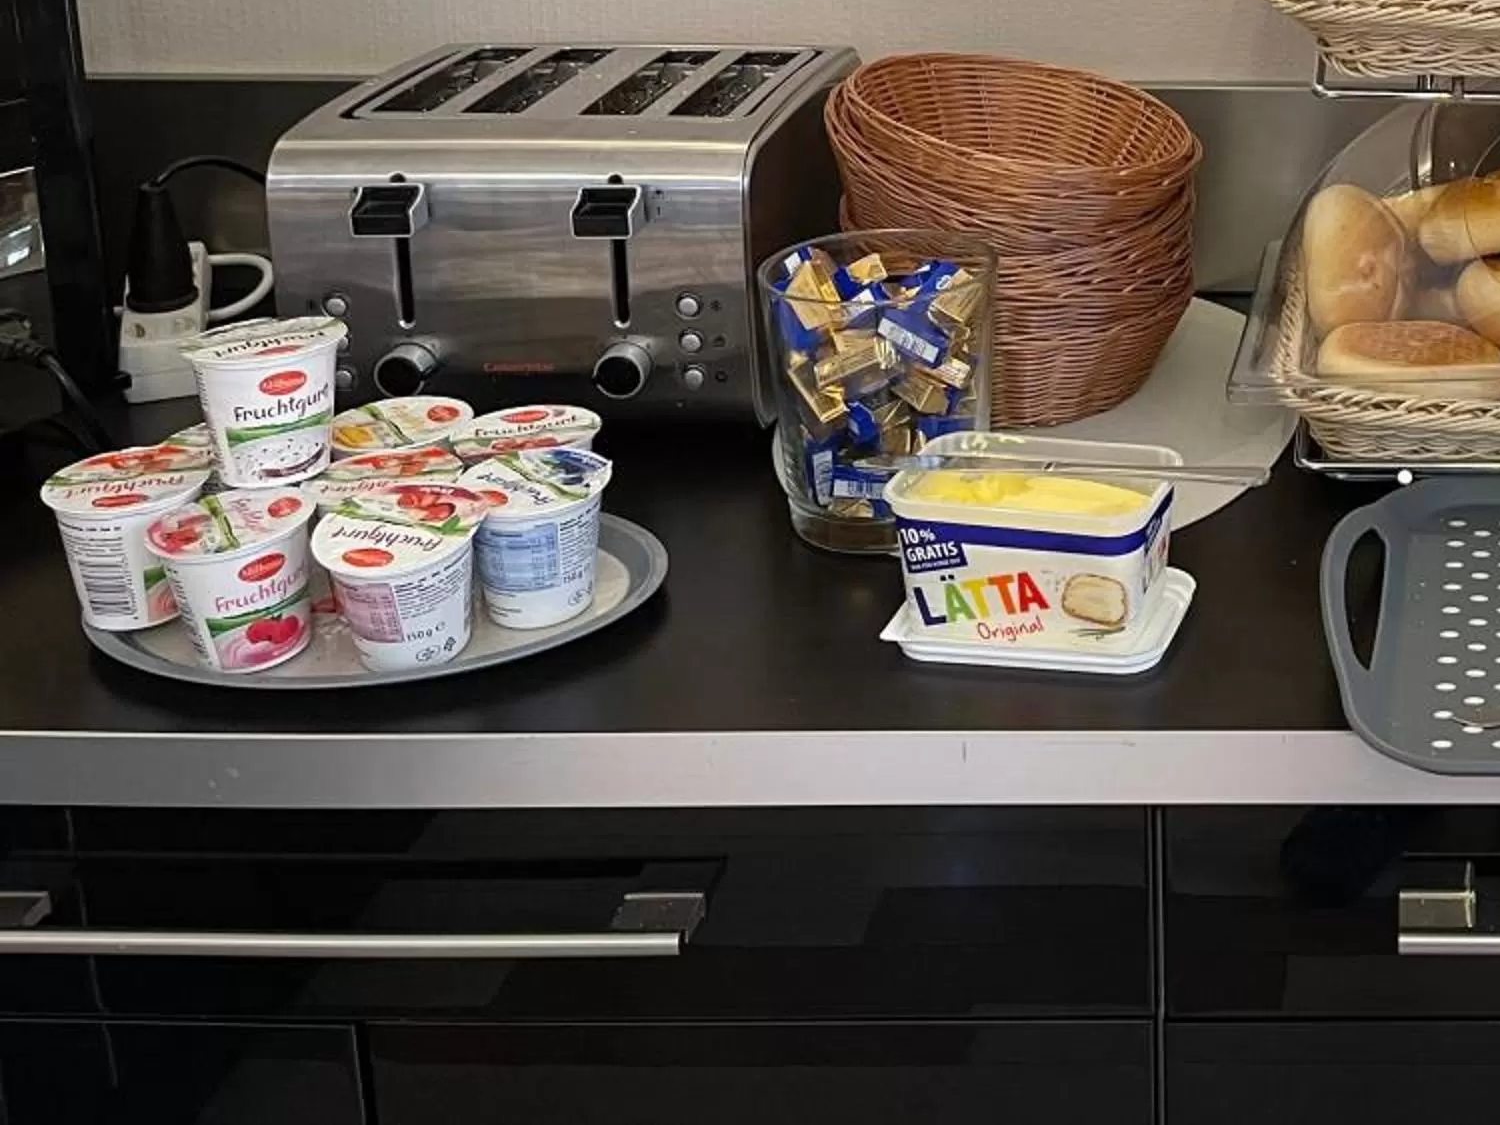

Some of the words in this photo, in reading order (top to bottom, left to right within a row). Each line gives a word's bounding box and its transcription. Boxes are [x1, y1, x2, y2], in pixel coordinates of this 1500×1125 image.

[233, 382, 330, 423] Fruchtgurt
[906, 540, 959, 563] GRATIS
[913, 572, 1050, 626] LÄTTA
[976, 615, 1045, 643] Original
